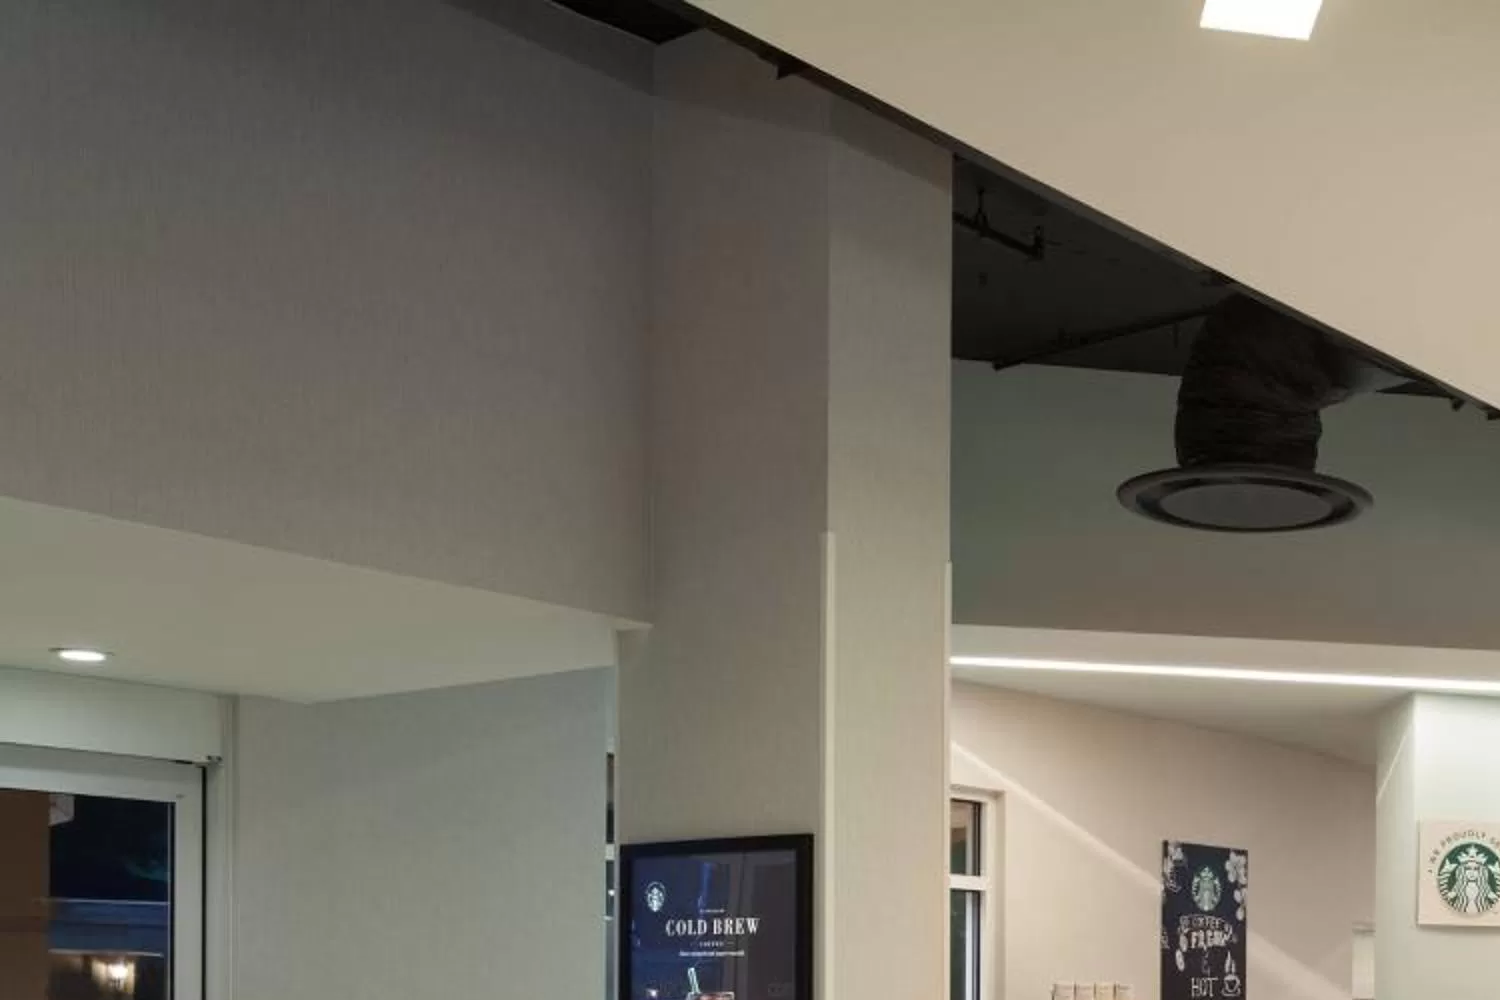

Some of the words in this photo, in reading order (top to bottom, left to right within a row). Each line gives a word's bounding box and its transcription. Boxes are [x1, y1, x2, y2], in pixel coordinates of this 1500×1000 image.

[665, 919, 708, 936] COLD
[713, 917, 761, 935] BREW
[1191, 977, 1219, 999] HOT
